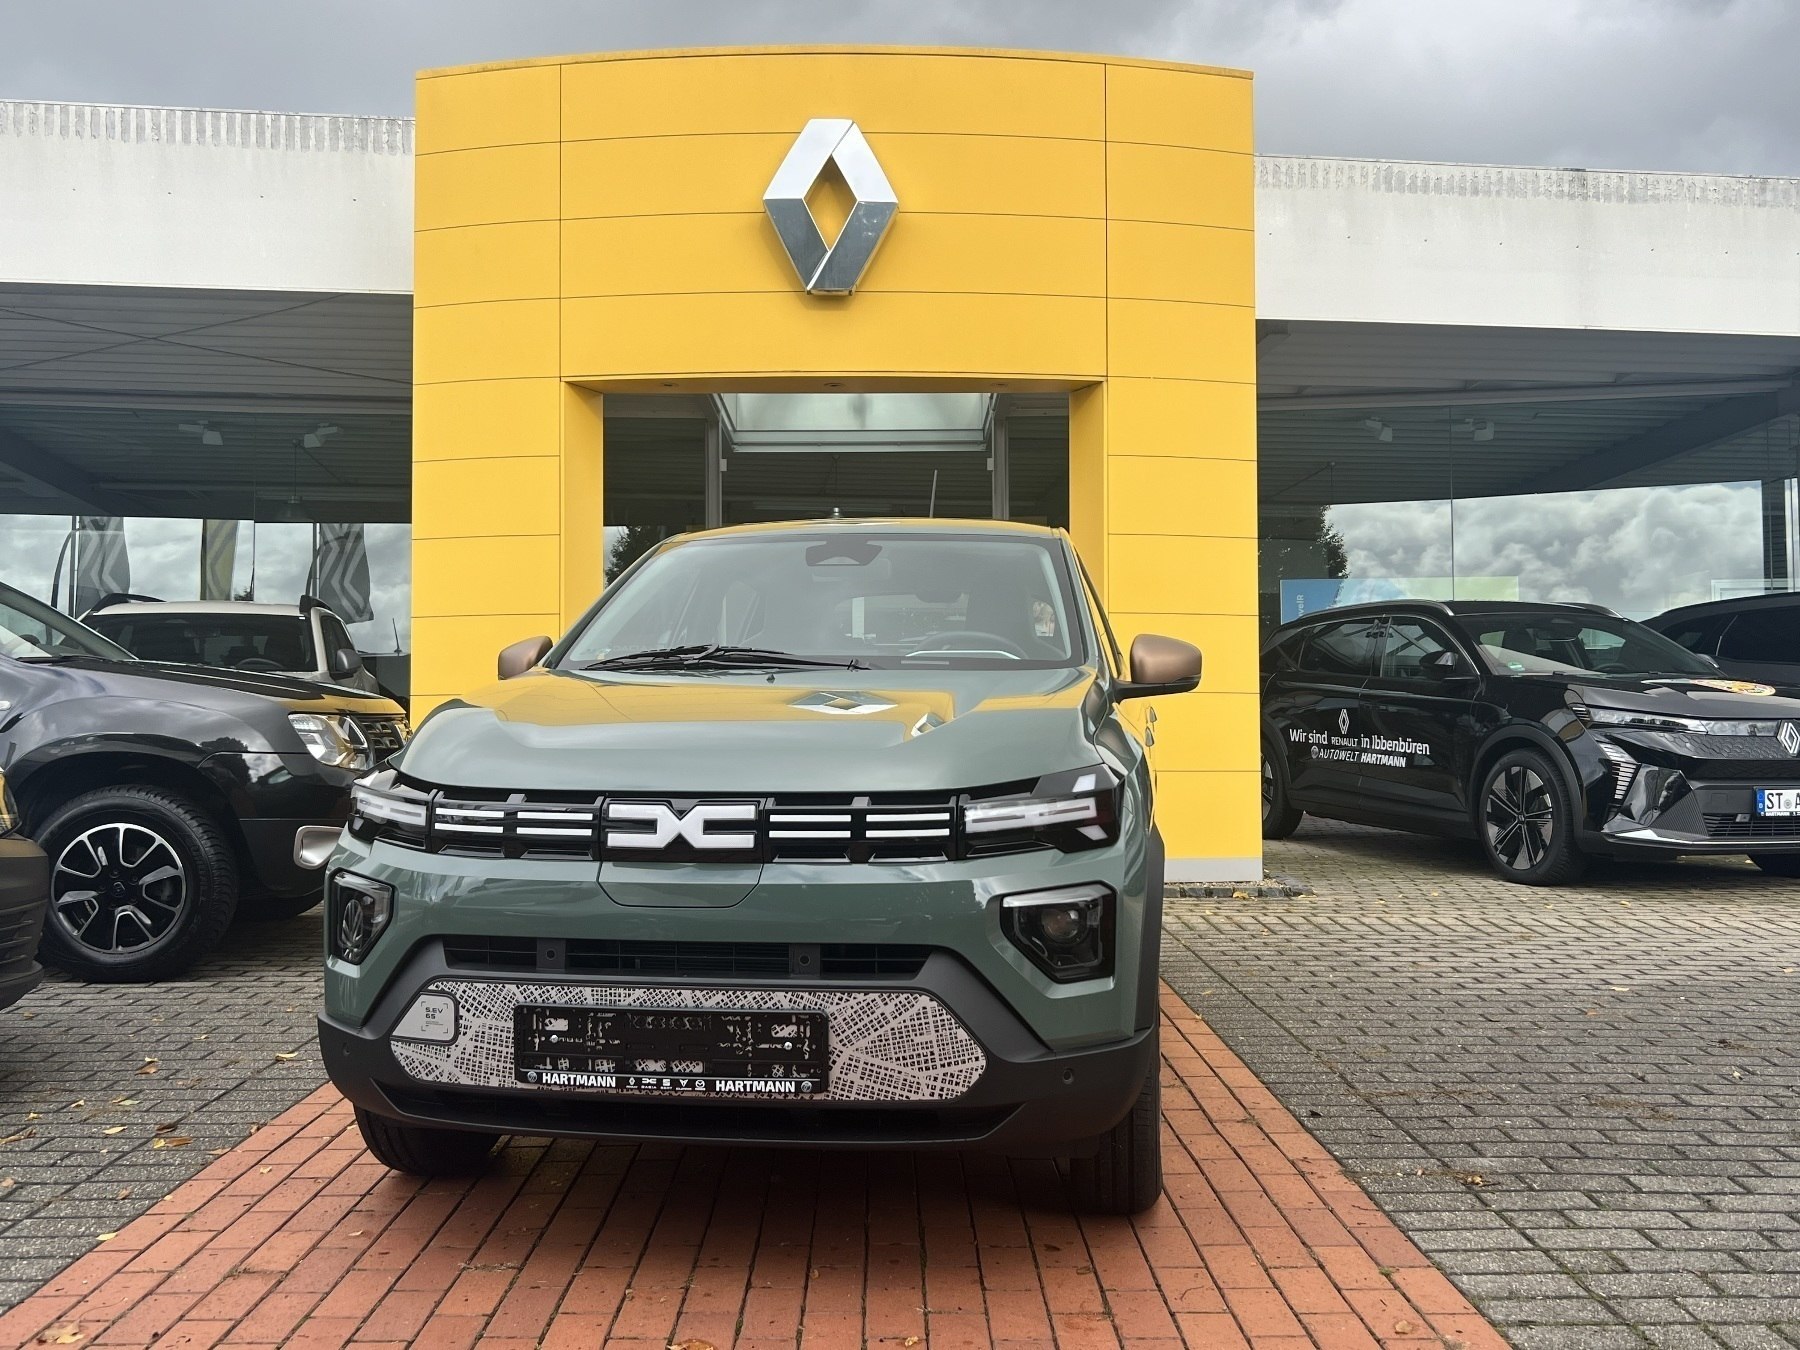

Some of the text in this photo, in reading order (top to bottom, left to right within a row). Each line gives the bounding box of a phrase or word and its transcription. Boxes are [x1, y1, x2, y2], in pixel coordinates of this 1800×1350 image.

[1290, 728, 1430, 755] Wir sind RENAULT in Ibbenbüren
[1319, 748, 1406, 767] AUTOWELT HARTMANN
[1766, 792, 1783, 809] ST
[542, 1072, 616, 1088] HARTMANN
[715, 1080, 796, 1093] HARTMANN
